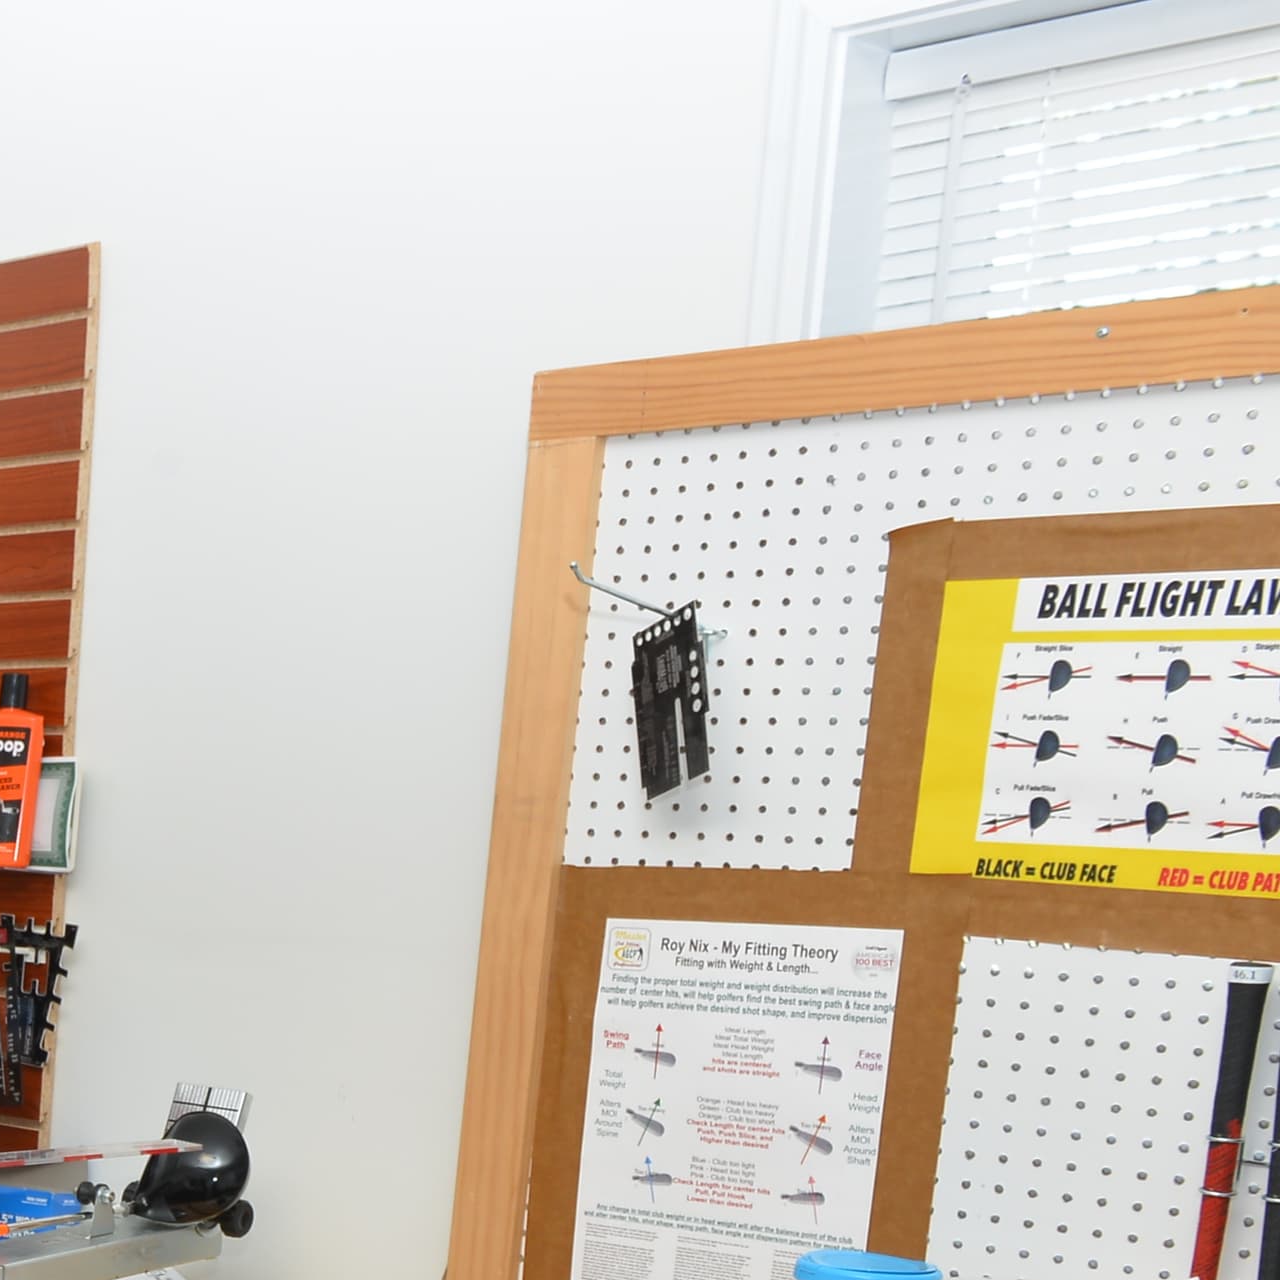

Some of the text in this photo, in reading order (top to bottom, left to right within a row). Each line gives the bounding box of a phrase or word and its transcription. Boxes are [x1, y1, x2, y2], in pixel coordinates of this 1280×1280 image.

[1037, 580, 1226, 619] BALL FLIGHT
[975, 858, 1024, 878] BLACK
[1040, 862, 1077, 881] CLUB
[1080, 863, 1118, 884] FACE
[1158, 867, 1190, 887] RED
[1209, 870, 1249, 890] CLUB
[660, 937, 686, 953] Roy
[690, 939, 709, 953] Nix
[721, 941, 743, 958] My
[745, 942, 788, 961] Fitting
[792, 944, 839, 963] Theory
[675, 956, 705, 971] Fitting
[707, 959, 727, 969] with
[729, 960, 765, 973] Weight
[767, 962, 774, 971] &
[612, 973, 639, 985] Finding
[640, 976, 652, 985] the
[680, 978, 697, 987] total
[699, 981, 725, 991] weight
[728, 982, 741, 990] and
[743, 983, 771, 994] weight
[772, 984, 819, 995] distribution
[821, 986, 835, 995] will
[836, 988, 872, 999] increase
[874, 990, 888, 999] the
[698, 991, 715, 1001] help
[716, 993, 744, 1004] golfers
[746, 994, 762, 1003] find
[764, 995, 777, 1005] the
[778, 996, 796, 1006] best
[798, 998, 822, 1009] swing
[824, 999, 842, 1009] path
[853, 1001, 871, 1011] face
[696, 1004, 708, 1013] the
[710, 1005, 740, 1014] desired
[742, 1007, 761, 1016] shot
[791, 1010, 806, 1019] and
[807, 1011, 841, 1022] improve
[843, 1012, 888, 1025] dispersion
[603, 1030, 630, 1041] Swing
[606, 1040, 626, 1049] Path
[858, 1049, 882, 1060] Face
[855, 1061, 883, 1072] Angle
